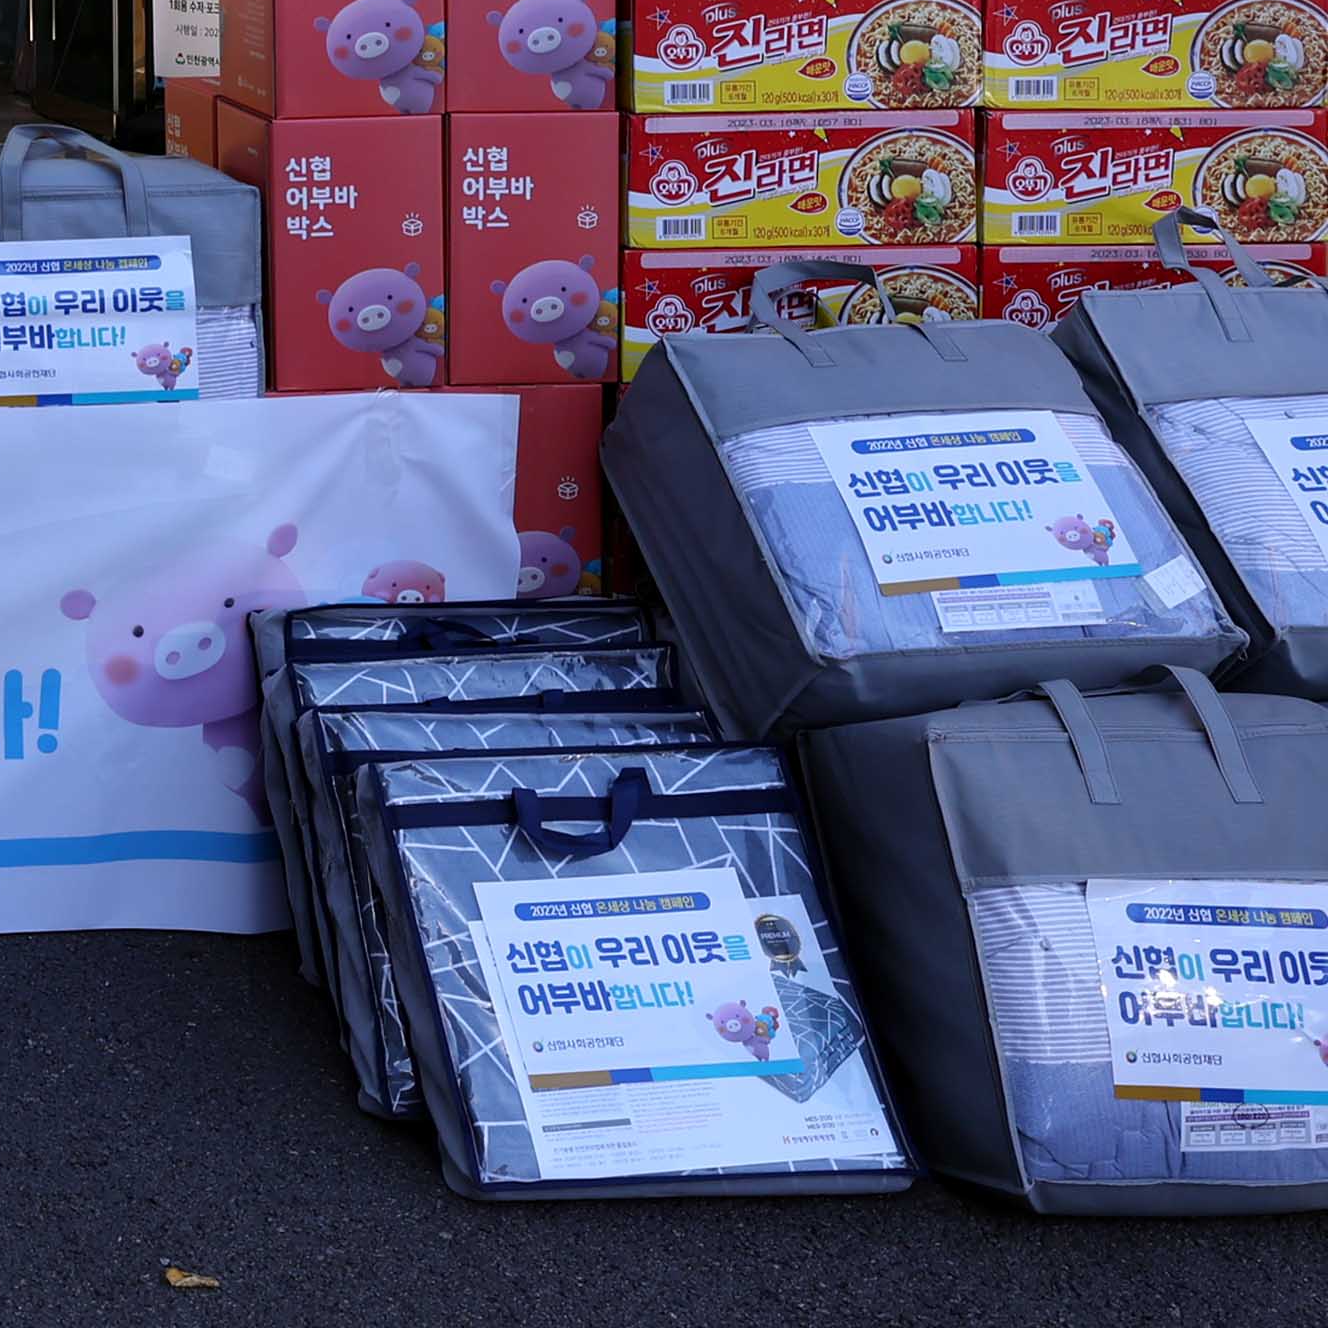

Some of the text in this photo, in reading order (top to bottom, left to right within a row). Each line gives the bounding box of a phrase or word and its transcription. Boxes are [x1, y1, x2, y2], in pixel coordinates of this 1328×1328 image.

[712, 13, 829, 70] 진라면
[1055, 9, 1174, 69] 진라면
[285, 155, 332, 182] 신협
[462, 146, 509, 172] 신협
[462, 176, 534, 201] 어부바
[1013, 178, 1047, 194] 오뚜기
[1057, 146, 1176, 206] 진라면
[285, 185, 358, 211] 어부바
[286, 215, 334, 240] 박스
[462, 205, 510, 230] 박스
[53, 288, 106, 315] 우리
[112, 286, 185, 313] 이웃을
[848, 458, 1083, 499] 신협이 우리 이웃을
[863, 499, 1033, 533] 어부바합니다!
[505, 930, 752, 974] 신협이 우리 이웃을
[1209, 948, 1275, 984] 우리
[517, 980, 694, 1016] 어부바합니다!
